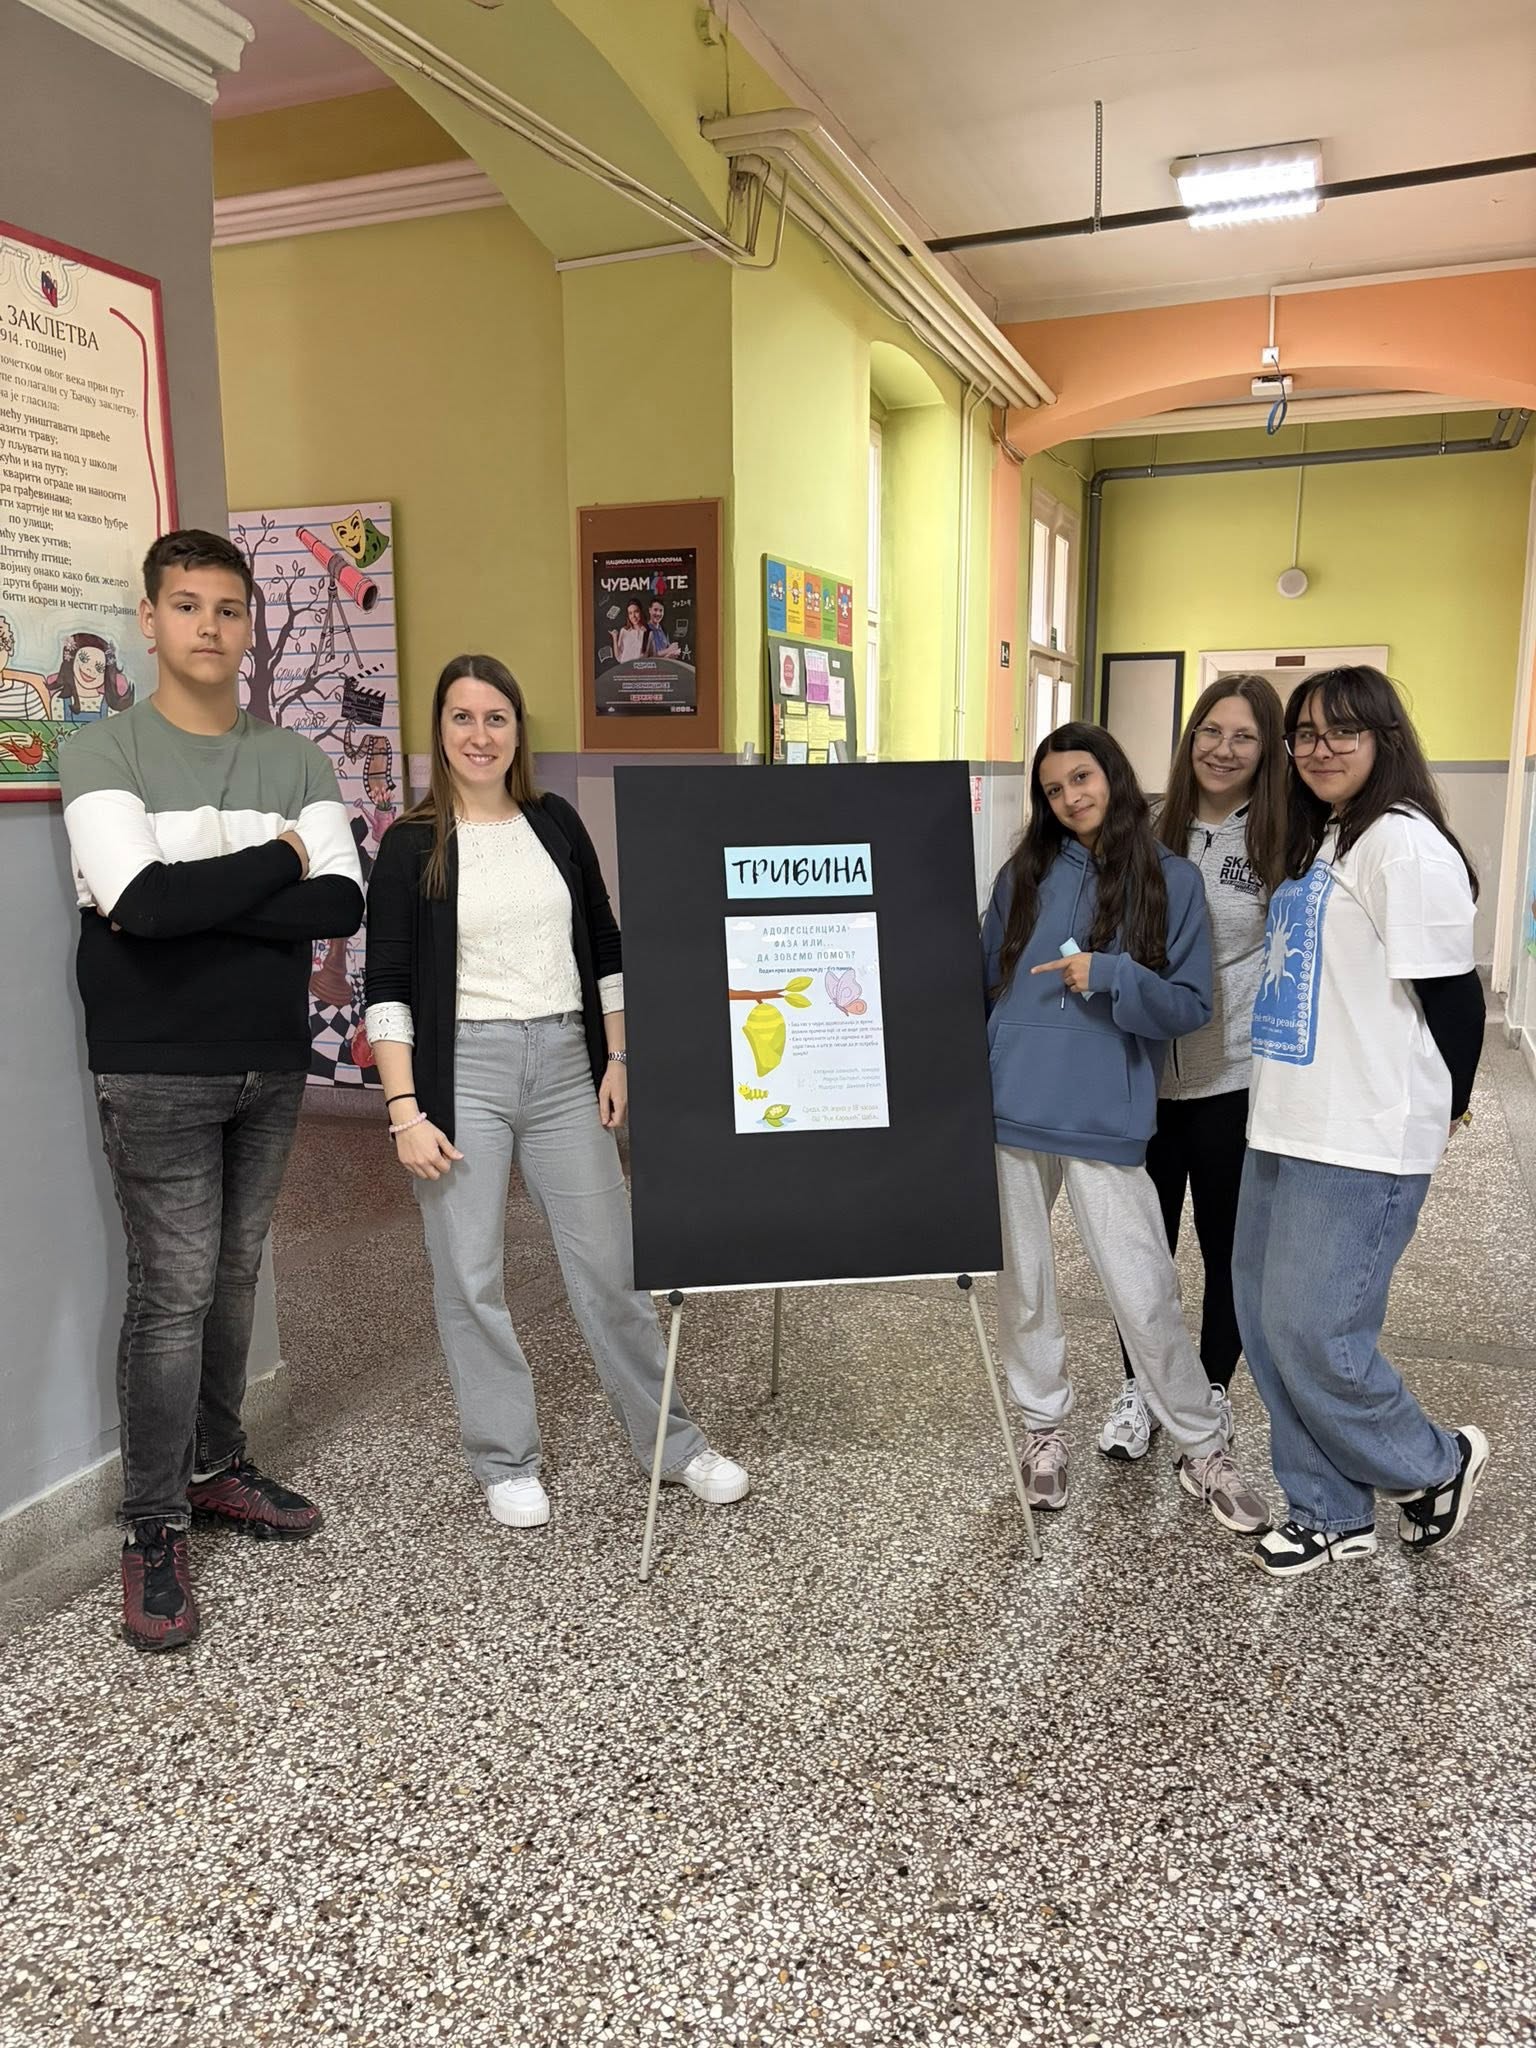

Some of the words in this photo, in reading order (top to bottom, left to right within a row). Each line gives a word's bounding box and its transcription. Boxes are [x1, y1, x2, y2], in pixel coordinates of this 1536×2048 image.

[7, 305, 99, 351] ЗАКЛЕТВА
[25, 339, 67, 361] године)
[44, 368, 64, 381] овог
[66, 374, 86, 386] века
[87, 379, 109, 394] први
[110, 386, 125, 398] пут
[10, 389, 19, 402] је
[21, 394, 60, 412] гласила:
[14, 376, 58, 394] полагали
[59, 389, 69, 400] су
[69, 388, 97, 407] Ђачку
[99, 400, 139, 418] заклетву.
[23, 413, 78, 434] уништавати
[79, 427, 111, 442] дрвеће
[28, 430, 59, 445] траву;
[8, 440, 49, 456] пљувати
[51, 449, 62, 459] на
[63, 452, 80, 464] под
[81, 457, 88, 467] у
[89, 458, 118, 472] школи
[23, 458, 30, 467] и
[32, 460, 43, 470] на
[45, 462, 69, 476] путу;
[2, 468, 41, 484] кварити
[43, 477, 74, 490] ограде
[75, 484, 87, 493] ни
[88, 486, 127, 502] наносити
[13, 486, 73, 506] грађевинама;
[8, 514, 21, 524] по
[23, 516, 54, 531] улици;
[16, 500, 50, 516] хартије
[51, 507, 63, 517] ни
[65, 510, 76, 520] ма
[77, 512, 103, 525] какво
[104, 515, 129, 531] ђубре
[18, 532, 40, 545] увек
[42, 536, 72, 549] учтив;
[41, 553, 72, 566] птице;
[606, 558, 644, 566] НАЦИОНАЛНА
[645, 557, 682, 565] ПЛАТФОРМА
[2, 577, 31, 590] други
[32, 579, 59, 592] брани
[60, 584, 83, 597] моју;
[33, 566, 60, 578] онако
[62, 570, 83, 581] како
[84, 572, 100, 584] бих
[101, 576, 129, 588] желео
[2, 590, 26, 602] бити
[28, 594, 58, 607] искрен
[60, 598, 66, 606] и
[67, 599, 98, 612] честит
[731, 855, 867, 886] ТРИБИНА
[1223, 856, 1252, 871] SKA
[774, 939, 798, 949] ФАЗА
[757, 953, 770, 962] ДА
[774, 951, 813, 961] ЗОВЕМО
[817, 950, 856, 960] ПОМОЋ?
